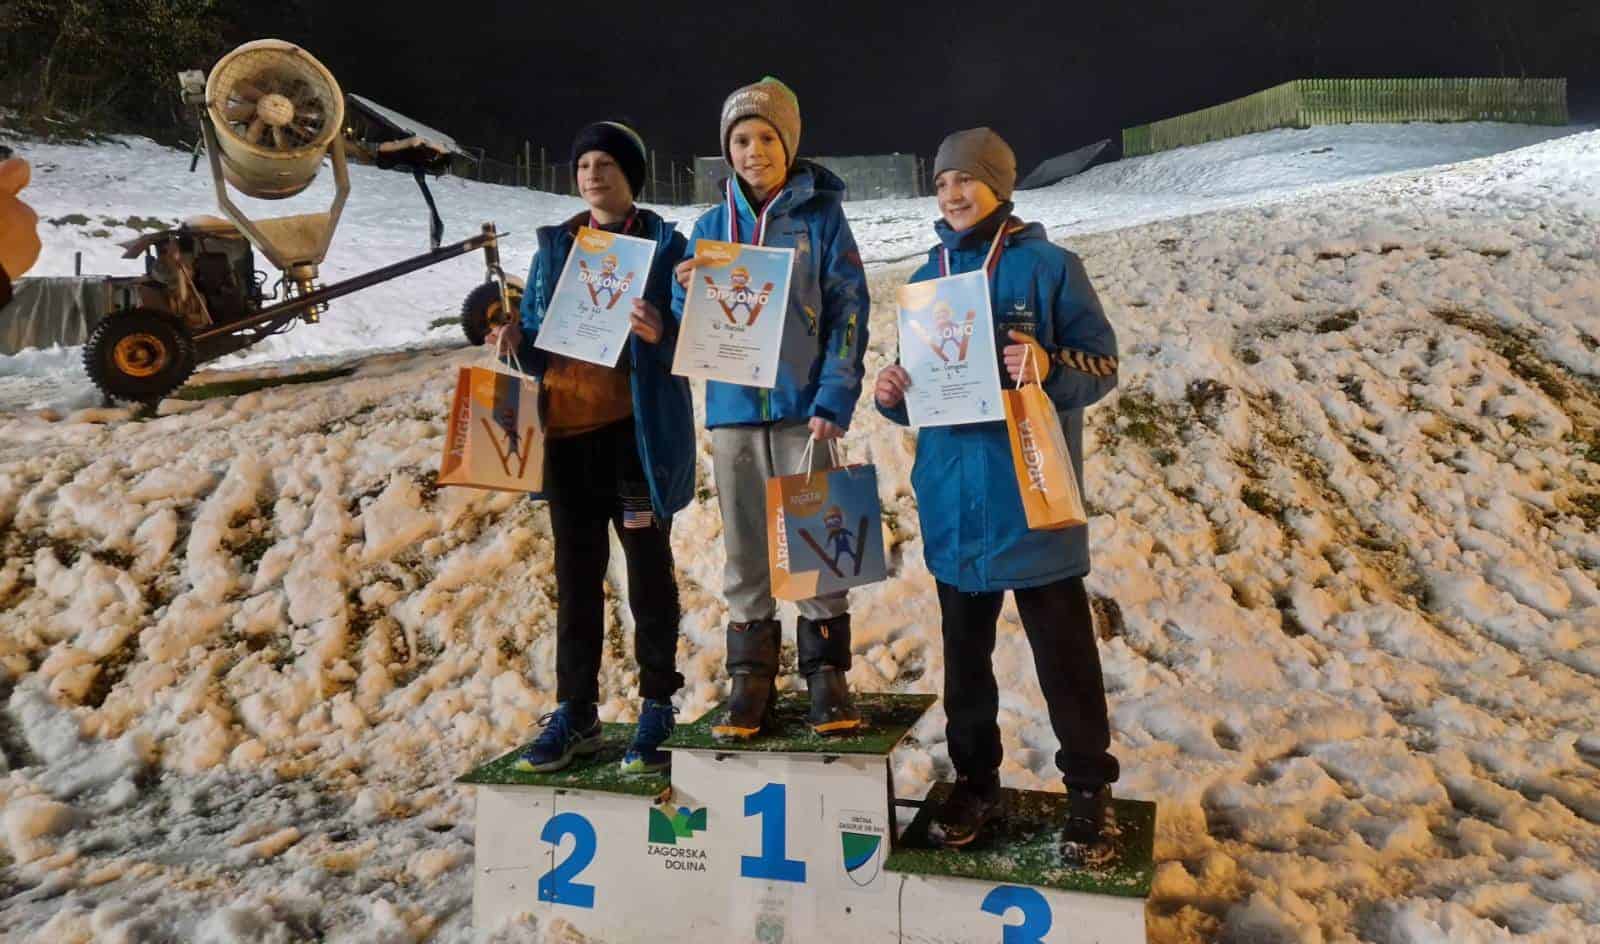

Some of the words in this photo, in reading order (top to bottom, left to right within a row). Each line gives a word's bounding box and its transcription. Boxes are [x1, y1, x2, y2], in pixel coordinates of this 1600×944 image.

[537, 812, 597, 909] 2
[647, 845, 707, 859] ZAGORSKA
[740, 783, 807, 883] 1
[664, 859, 706, 873] DOLINA
[981, 885, 1053, 944] 3
